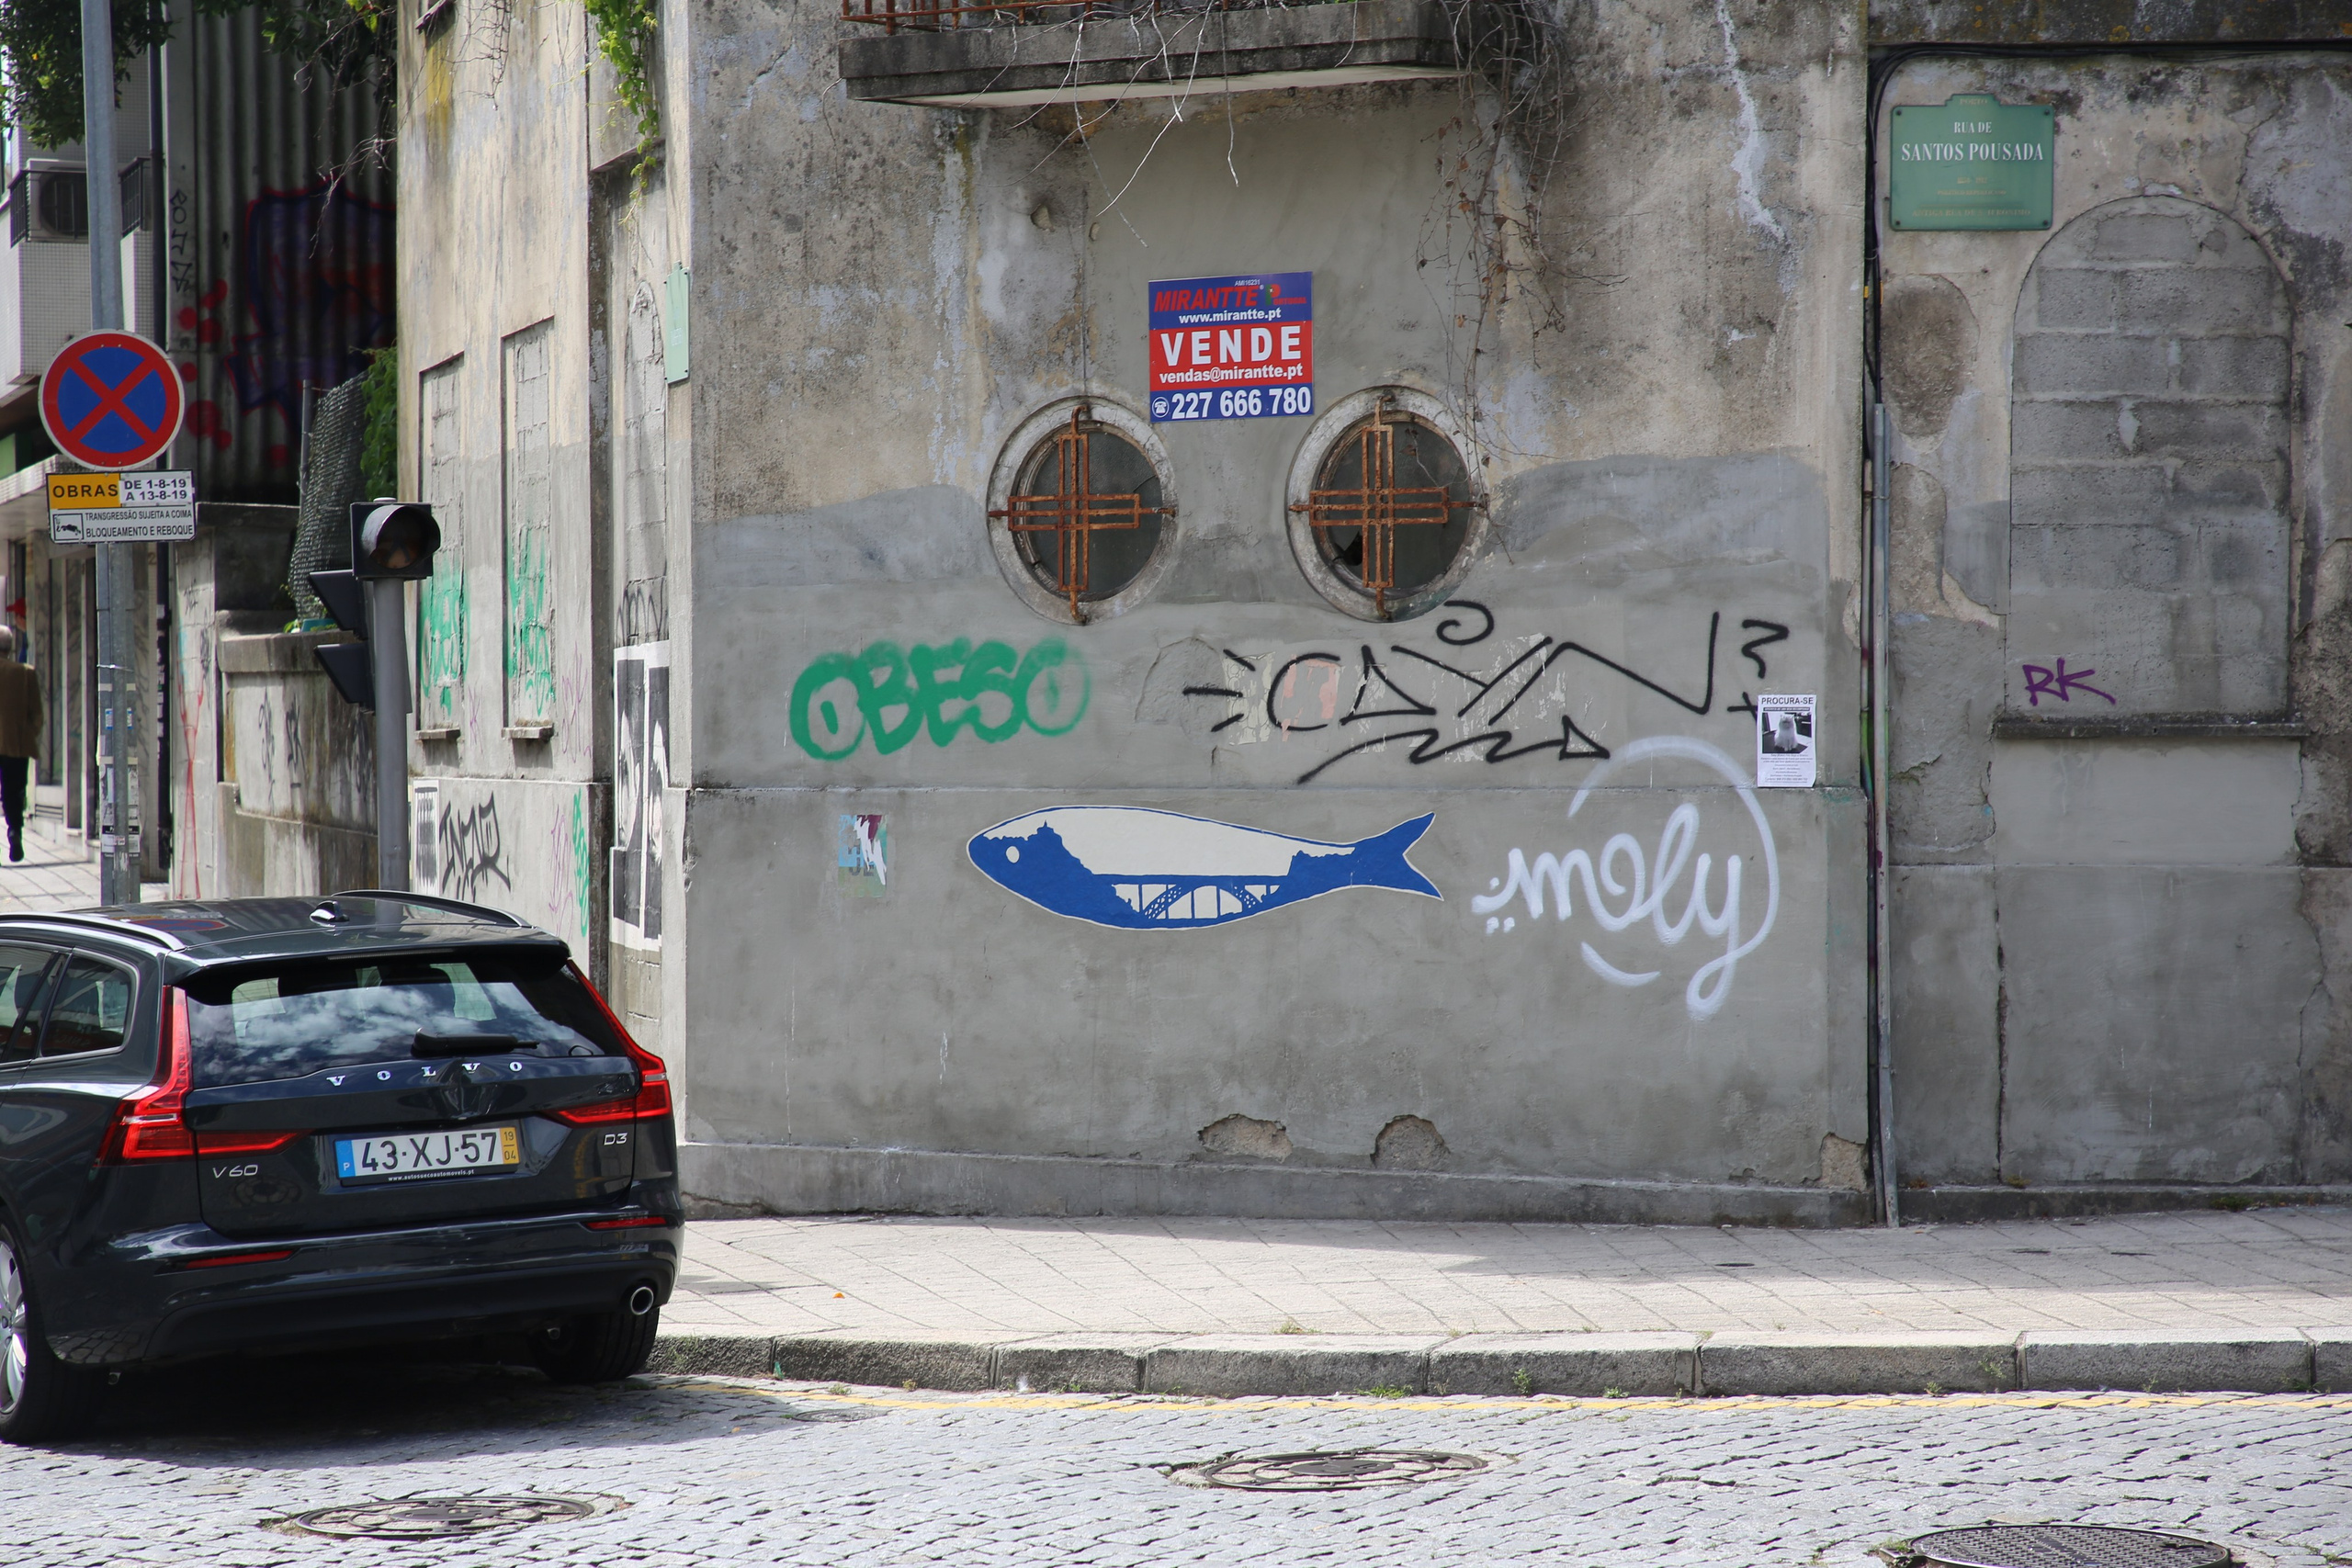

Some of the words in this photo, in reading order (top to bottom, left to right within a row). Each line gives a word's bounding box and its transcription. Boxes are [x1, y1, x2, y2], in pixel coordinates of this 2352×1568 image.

[1953, 121, 1975, 133] RUA
[1977, 121, 1992, 133] DE
[1901, 142, 1963, 162] SANTOS
[1968, 142, 2044, 161] POUSADA
[1153, 285, 1260, 312] MIRANTTE
[1179, 307, 1282, 324] www.mirantte.pt
[1160, 325, 1301, 367] VENDE
[1159, 363, 1304, 384] vendas@mirantte.pt
[1171, 391, 1213, 420] 227
[1219, 389, 1262, 417] 666
[1269, 386, 1311, 414] 780
[52, 484, 119, 498] OBRAS
[124, 479, 142, 491] DE
[146, 479, 187, 490] 1-8-19
[125, 491, 135, 502] A
[139, 490, 187, 501] 13-8-19
[85, 509, 138, 521] TRANSGRESSÃO
[138, 511, 164, 520] SUJEITA
[171, 510, 192, 518] COIMA
[85, 526, 149, 538] BLOQUEAMENTO
[150, 526, 155, 536] E
[156, 525, 193, 536] REBOQUE
[1761, 697, 1814, 705] PROCURA-SE
[326, 1061, 523, 1087] VOLVO
[503, 1131, 514, 1141] 19
[604, 1132, 628, 1146] D3
[503, 1150, 516, 1161] 04
[212, 1164, 258, 1179] V60
[343, 1162, 350, 1171] P
